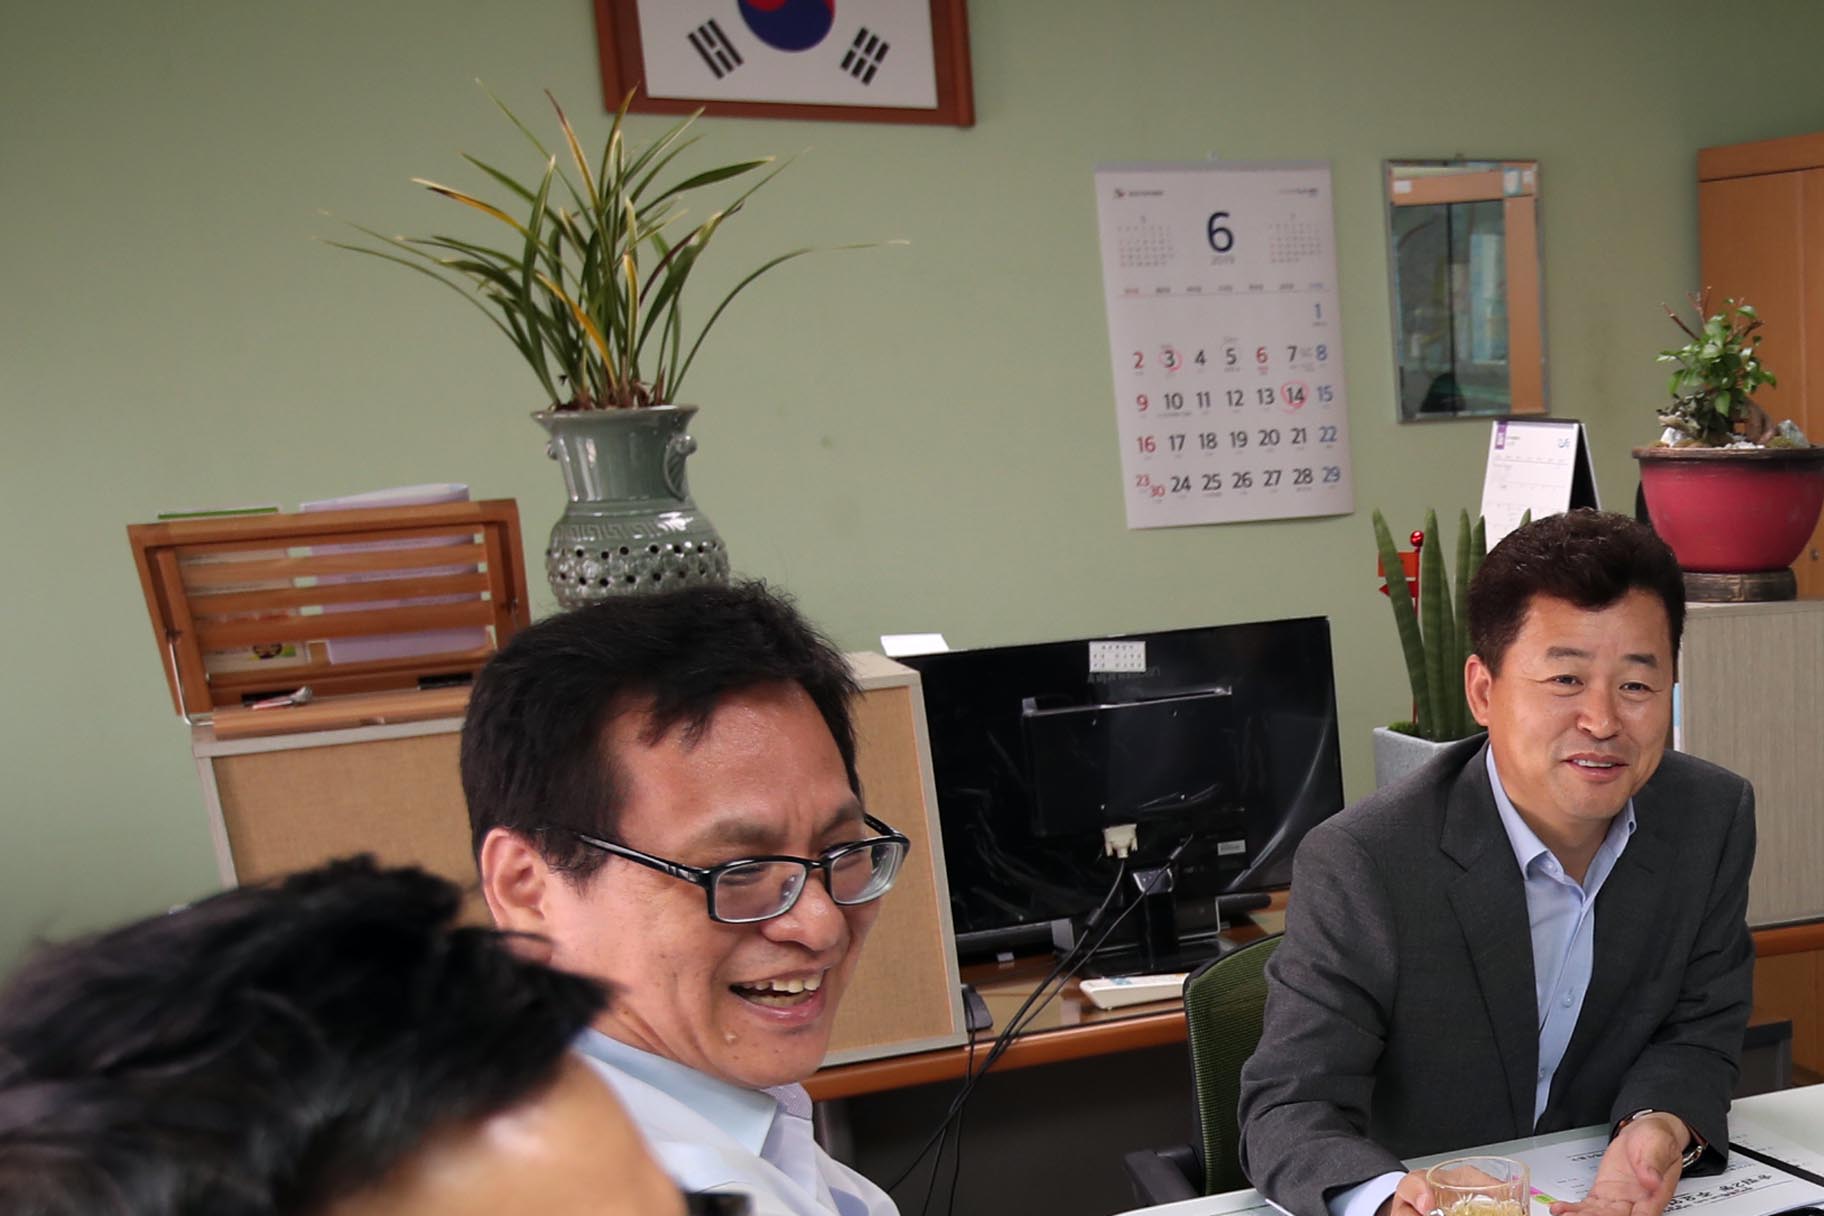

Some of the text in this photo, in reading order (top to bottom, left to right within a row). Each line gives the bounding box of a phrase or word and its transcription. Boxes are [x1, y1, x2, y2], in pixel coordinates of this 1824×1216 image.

[1206, 211, 1235, 253] 6
[1314, 303, 1323, 319] 1
[1133, 345, 1328, 369] 2 3 4 5 6 7 8
[1137, 385, 1334, 412] 9 10 11 12 13 14 15
[1137, 425, 1338, 453] 16 17 18 19 20 21 22
[1135, 466, 1341, 498] 23 30 24 25 26 27 28 29
